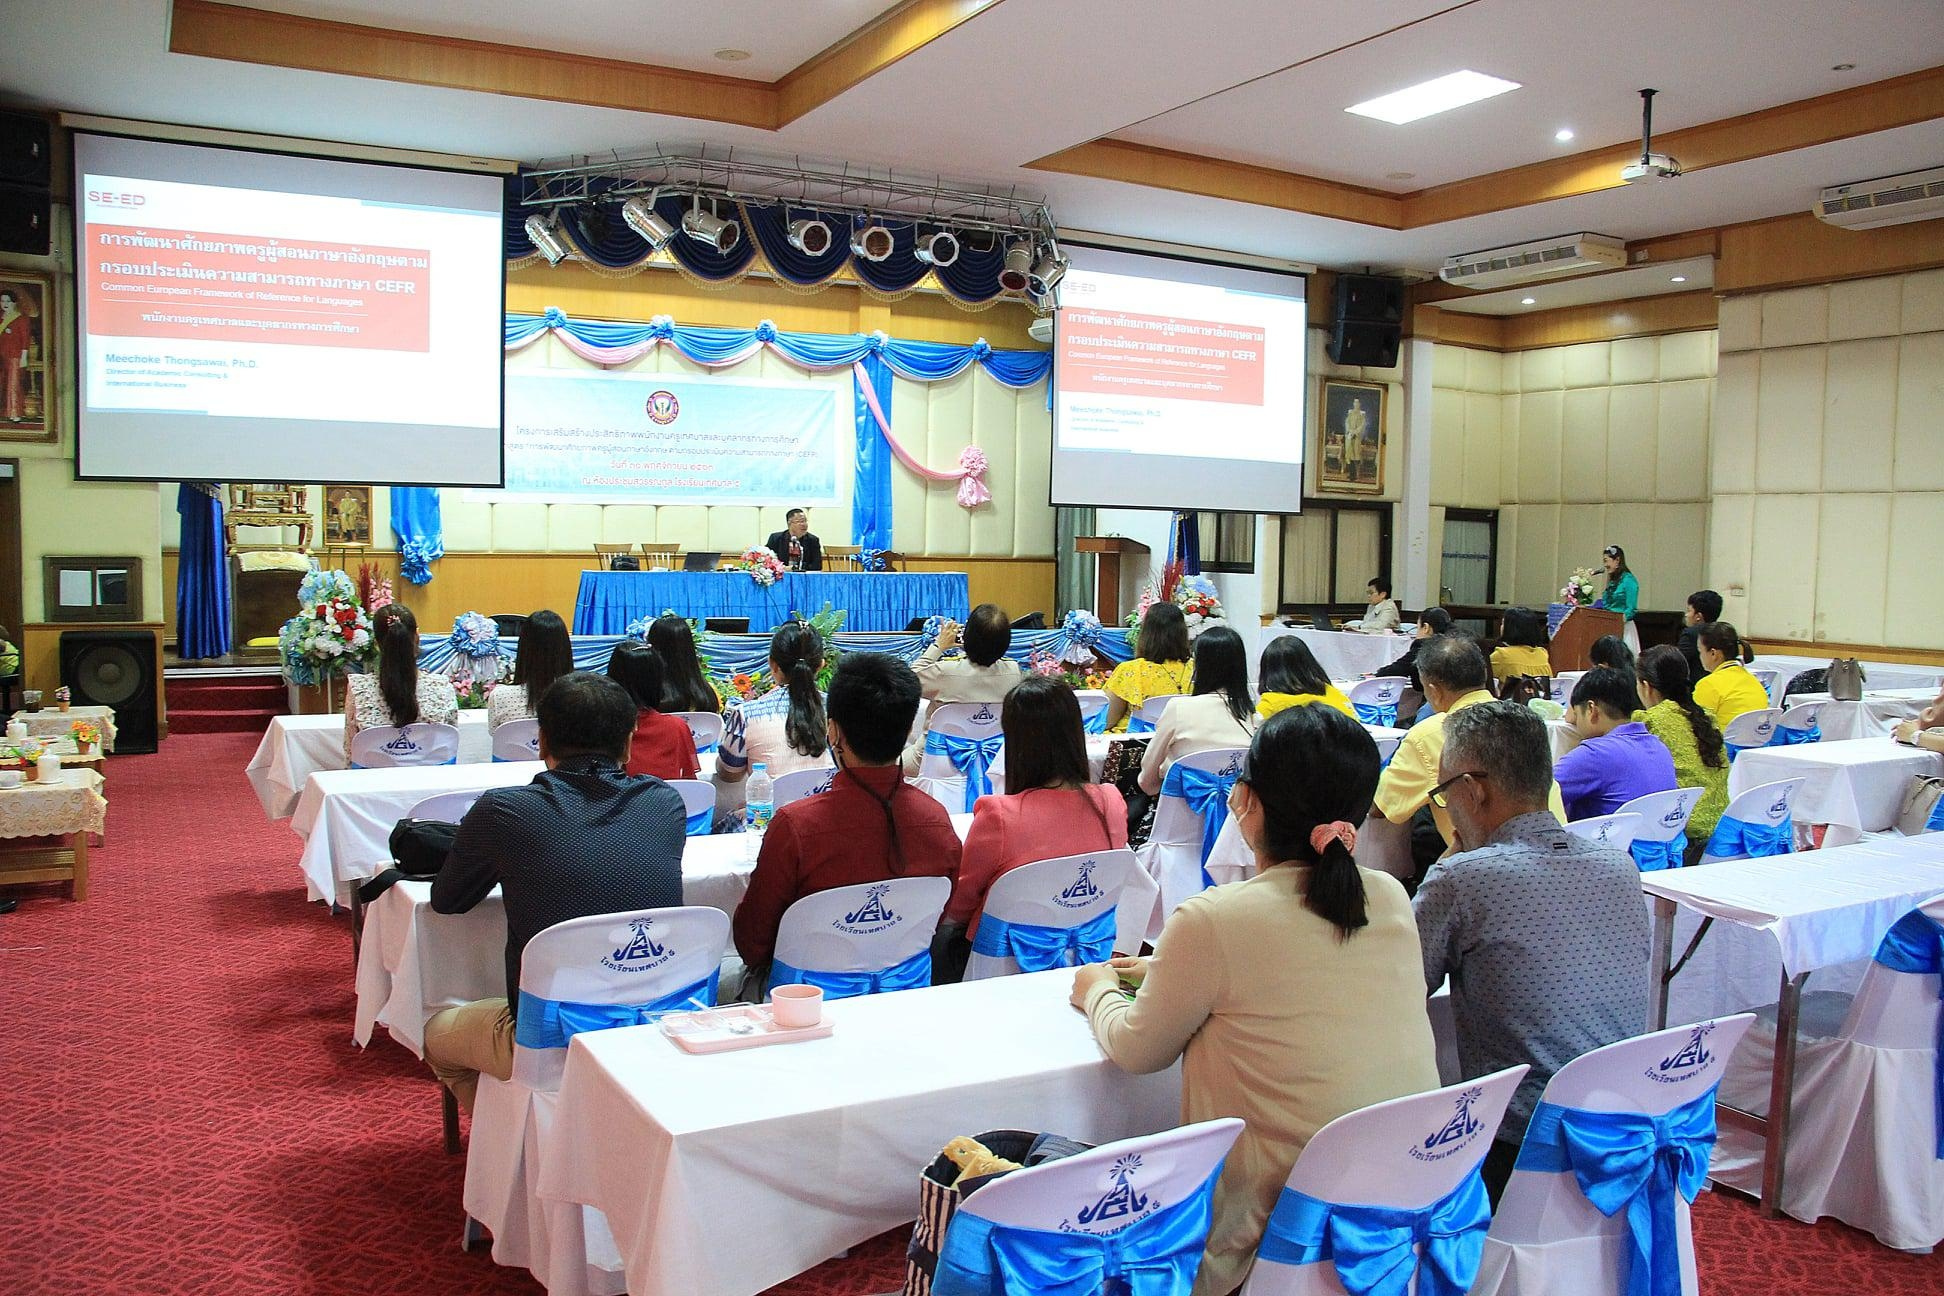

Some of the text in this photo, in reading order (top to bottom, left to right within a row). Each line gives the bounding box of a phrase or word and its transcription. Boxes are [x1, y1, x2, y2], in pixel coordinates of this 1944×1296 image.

[88, 190, 146, 206] SE-ED
[99, 230, 428, 269] การพัฒนาศักยภาพครูผู้สอนภาษาอังกฤษตาม
[99, 260, 416, 294] กรอบประเมินความสามารถทางภาษา CEFR
[101, 281, 364, 308] Common European Framework of Reference for Languages
[105, 353, 161, 364] Meechoke
[1231, 349, 1257, 362] CEFR
[600, 955, 669, 973] โรงเรียนเทศบาล
